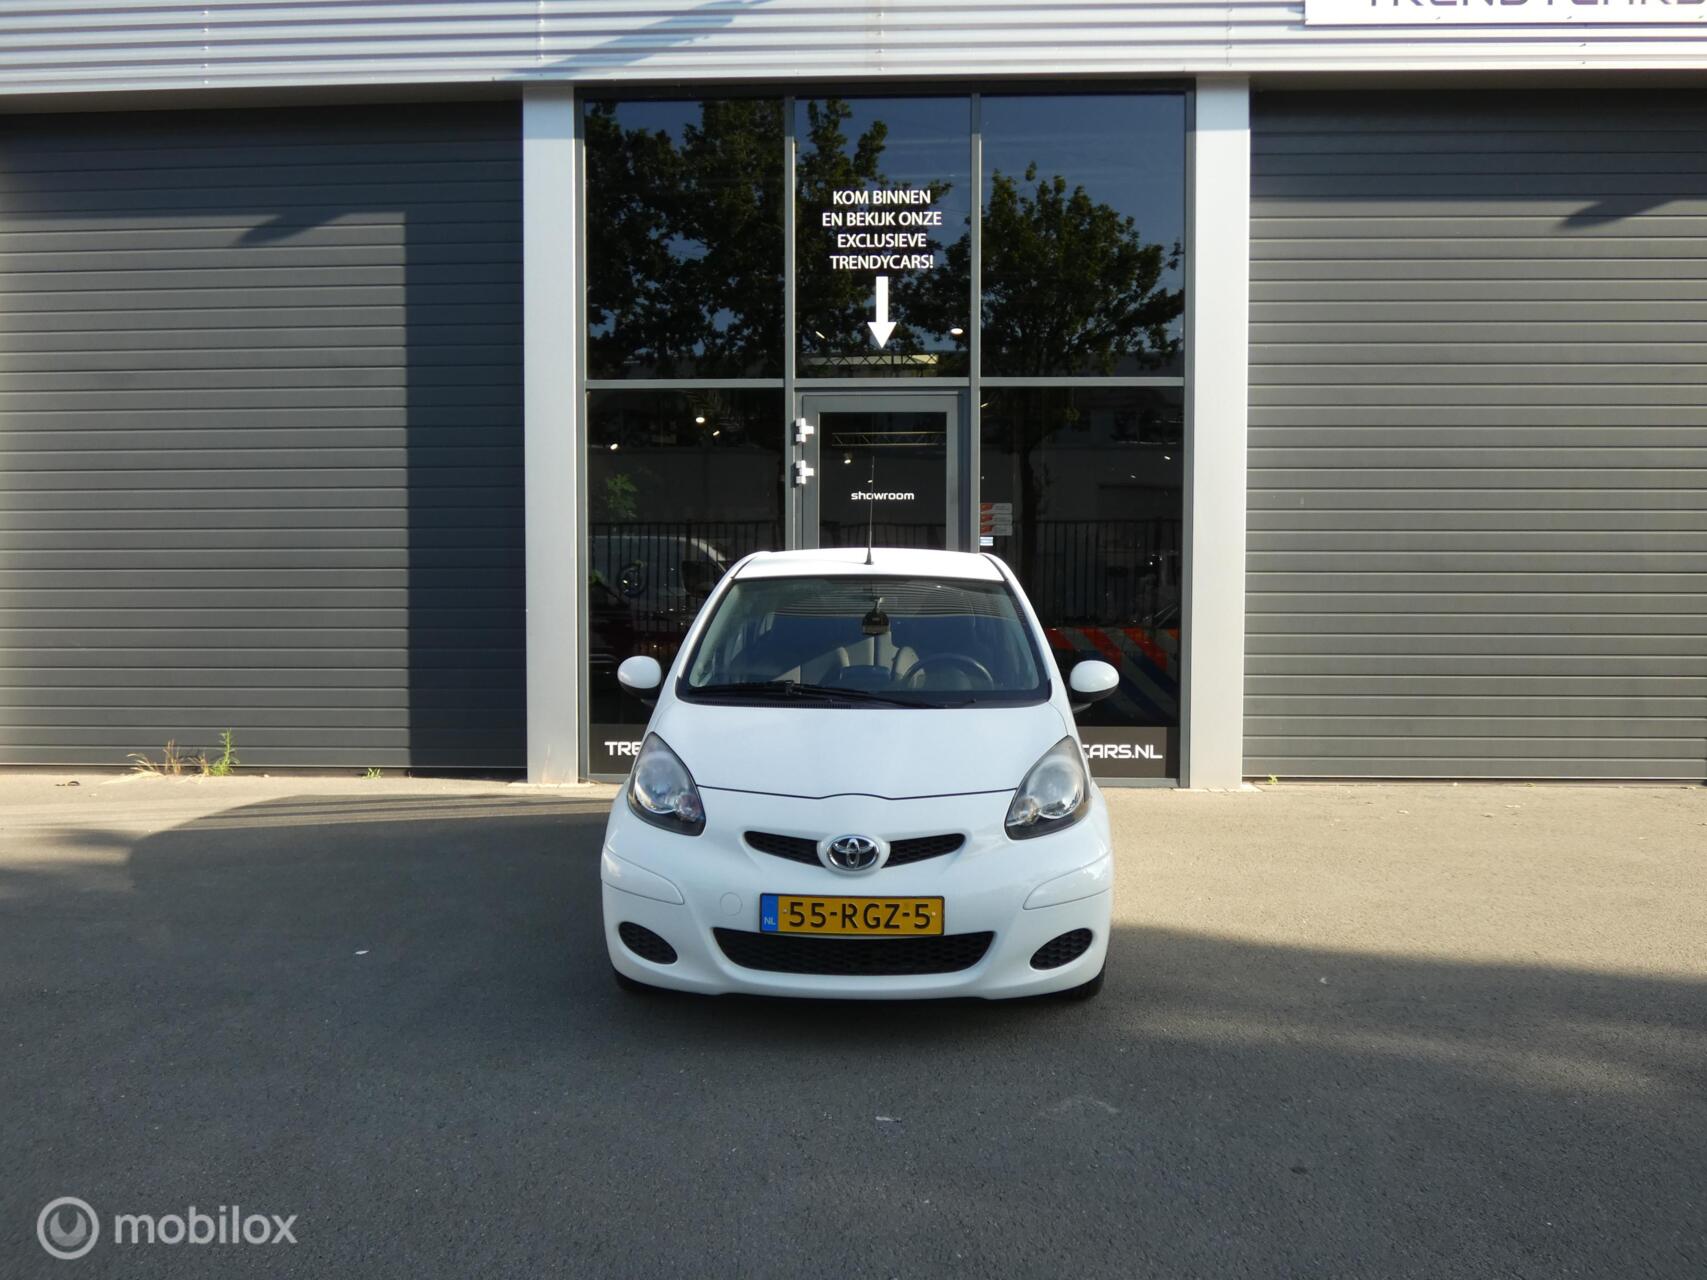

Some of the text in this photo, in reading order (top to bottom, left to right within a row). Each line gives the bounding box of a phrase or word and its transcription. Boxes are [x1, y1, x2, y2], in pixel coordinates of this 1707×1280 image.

[832, 189, 931, 205] KOM BINNEN
[822, 211, 942, 227] EN BEKIJK ONZE
[837, 233, 927, 248] EXCLUSIEVE
[829, 254, 934, 270] TRENDYCARS!
[850, 490, 915, 500] showroom
[763, 901, 931, 930] NL 55-RGZ-5
